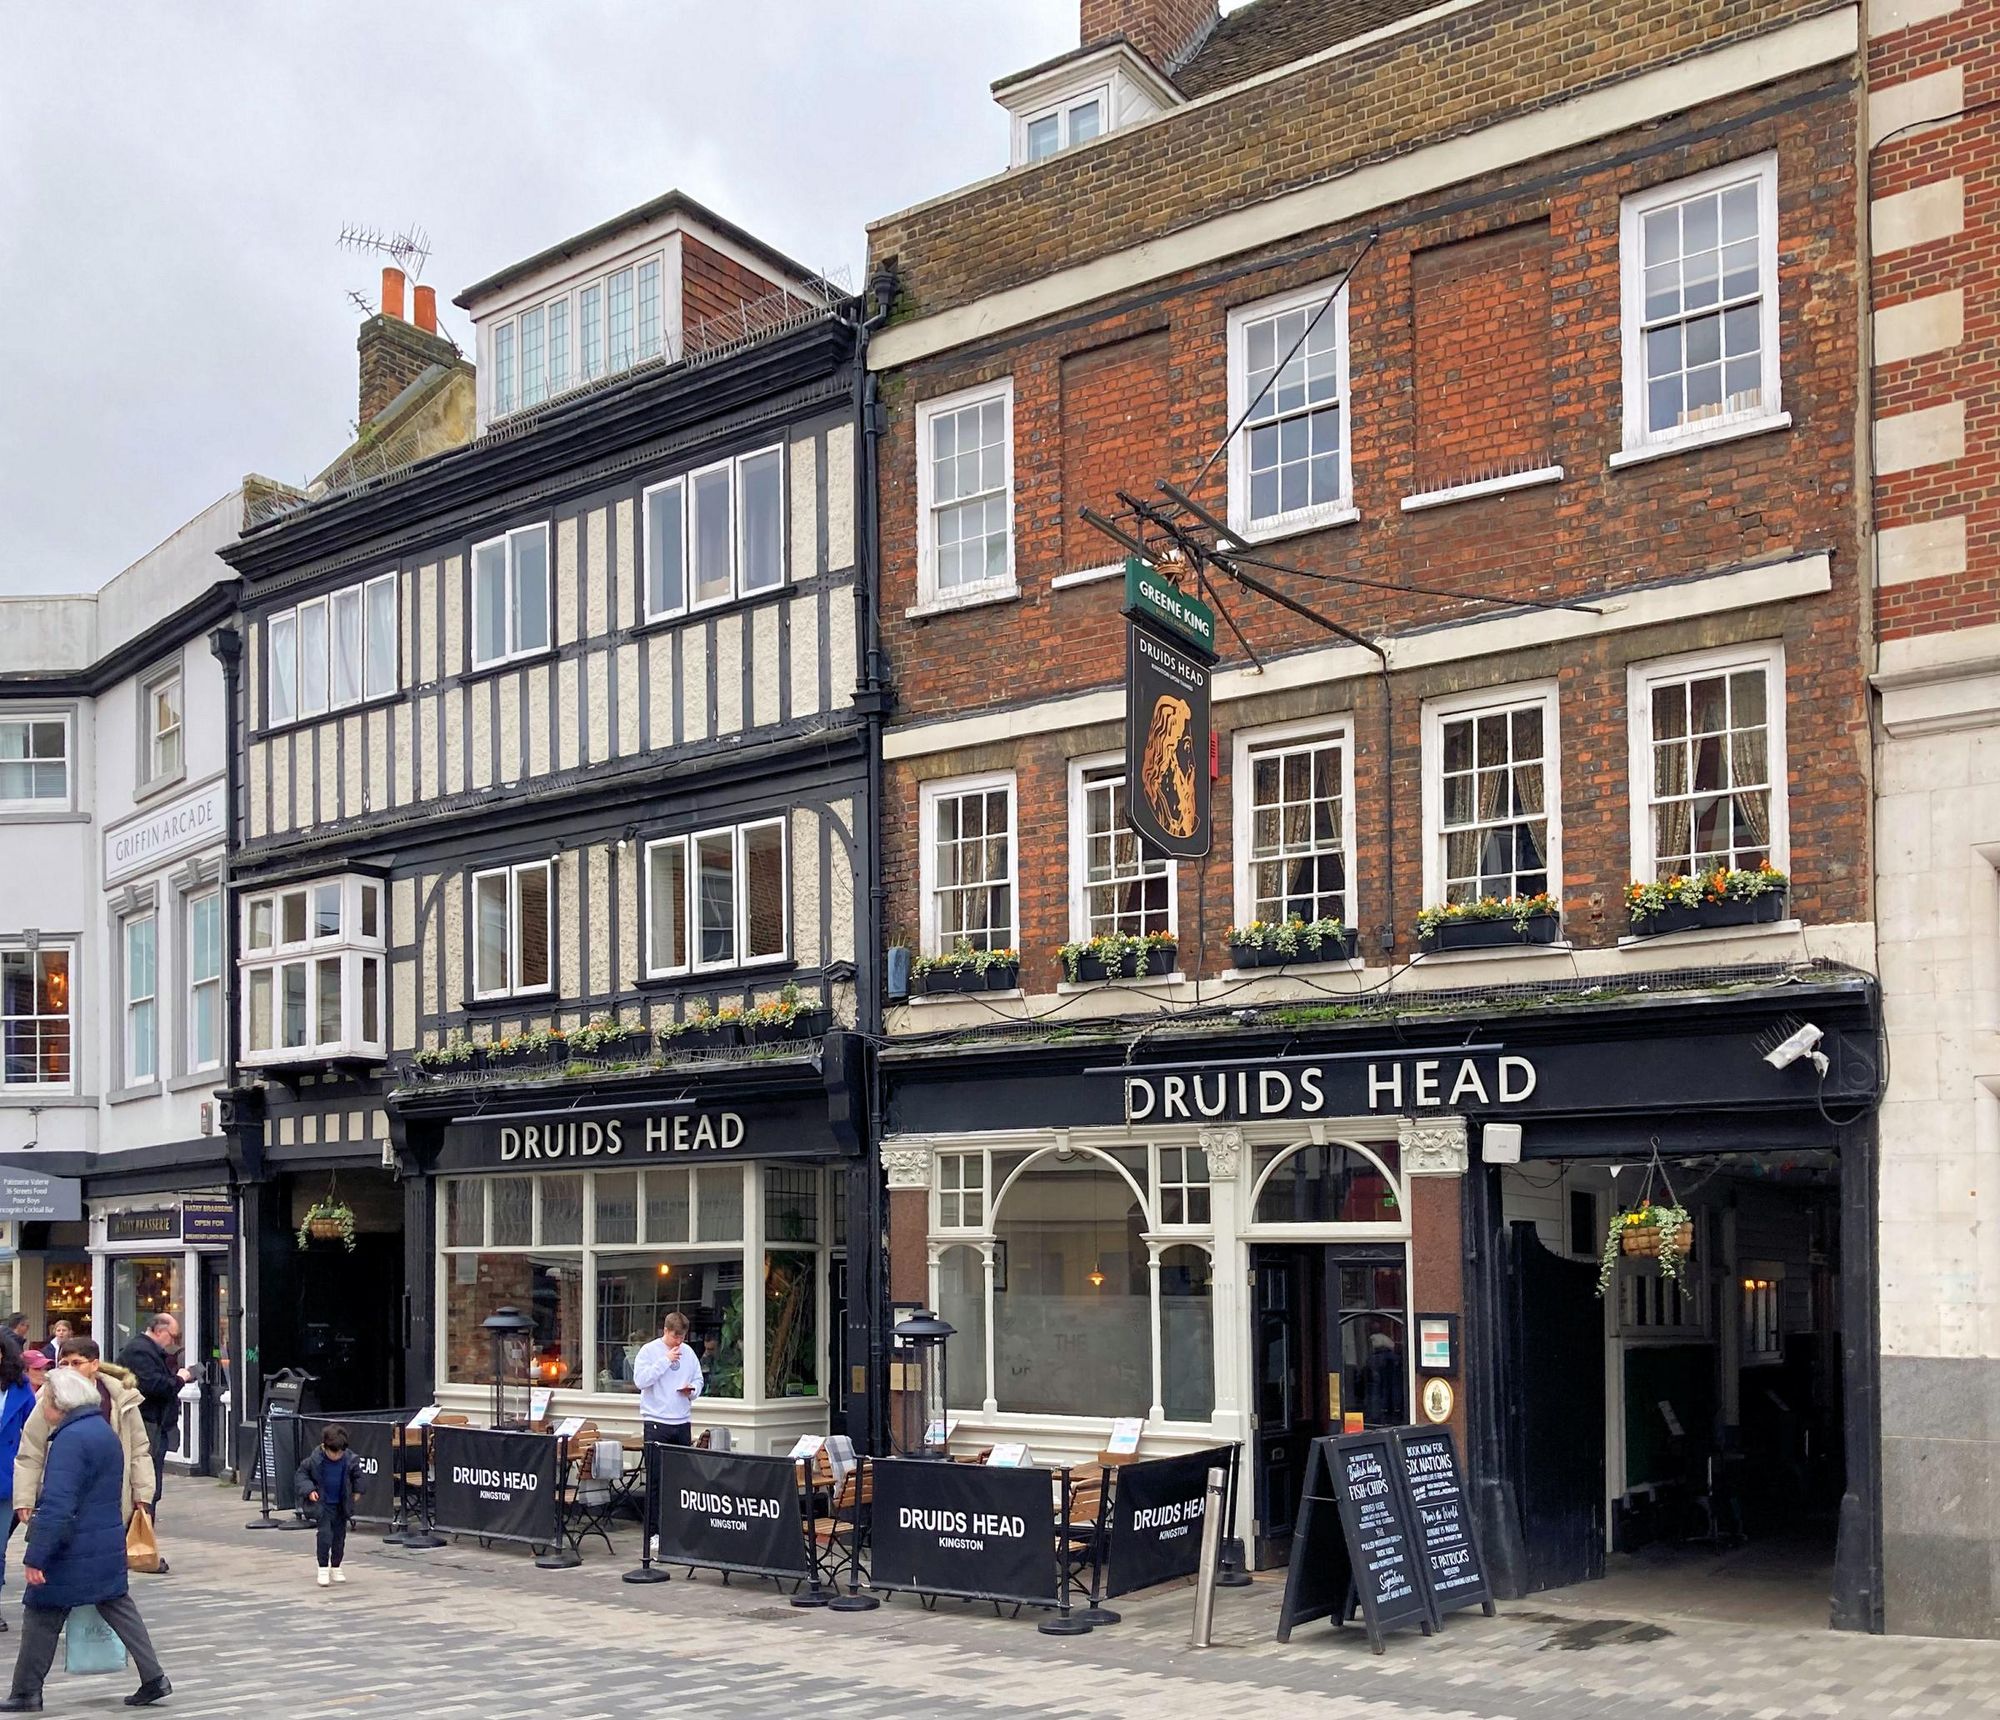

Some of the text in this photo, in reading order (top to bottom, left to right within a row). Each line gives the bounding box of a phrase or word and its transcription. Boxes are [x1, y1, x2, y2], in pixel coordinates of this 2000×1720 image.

[1139, 580, 1210, 638] GREENE KING
[1139, 638, 1204, 687] DRUIDS HEAD
[115, 800, 214, 862] GRIFFIN ARCADE
[1124, 1056, 1537, 1119] DRUIDS HEAD
[500, 1113, 745, 1161] DRUIDS HEAD
[26, 1197, 41, 1206] Boys
[33, 1187, 48, 1195] Food
[134, 1217, 171, 1232] BRASSERIE
[194, 1219, 225, 1227] OPEN FOR
[1406, 1442, 1444, 1457] BOOK NOW FOR
[359, 1457, 379, 1474] EAD
[1405, 1453, 1453, 1475] SIX NATIONS
[453, 1466, 538, 1490] DRUIDS HEAD
[480, 1490, 510, 1501] KINGSTON
[1348, 1483, 1366, 1500] FISH
[1367, 1479, 1389, 1496] CHIPS
[680, 1489, 780, 1519] DRUIDS HEAD
[1133, 1496, 1205, 1531] DRUIDS HEA
[709, 1517, 747, 1531] KINGSTON
[899, 1507, 1025, 1538] DRUIDS HEAD
[1159, 1525, 1189, 1540] KINGSTON
[939, 1537, 984, 1550] KINGSTON
